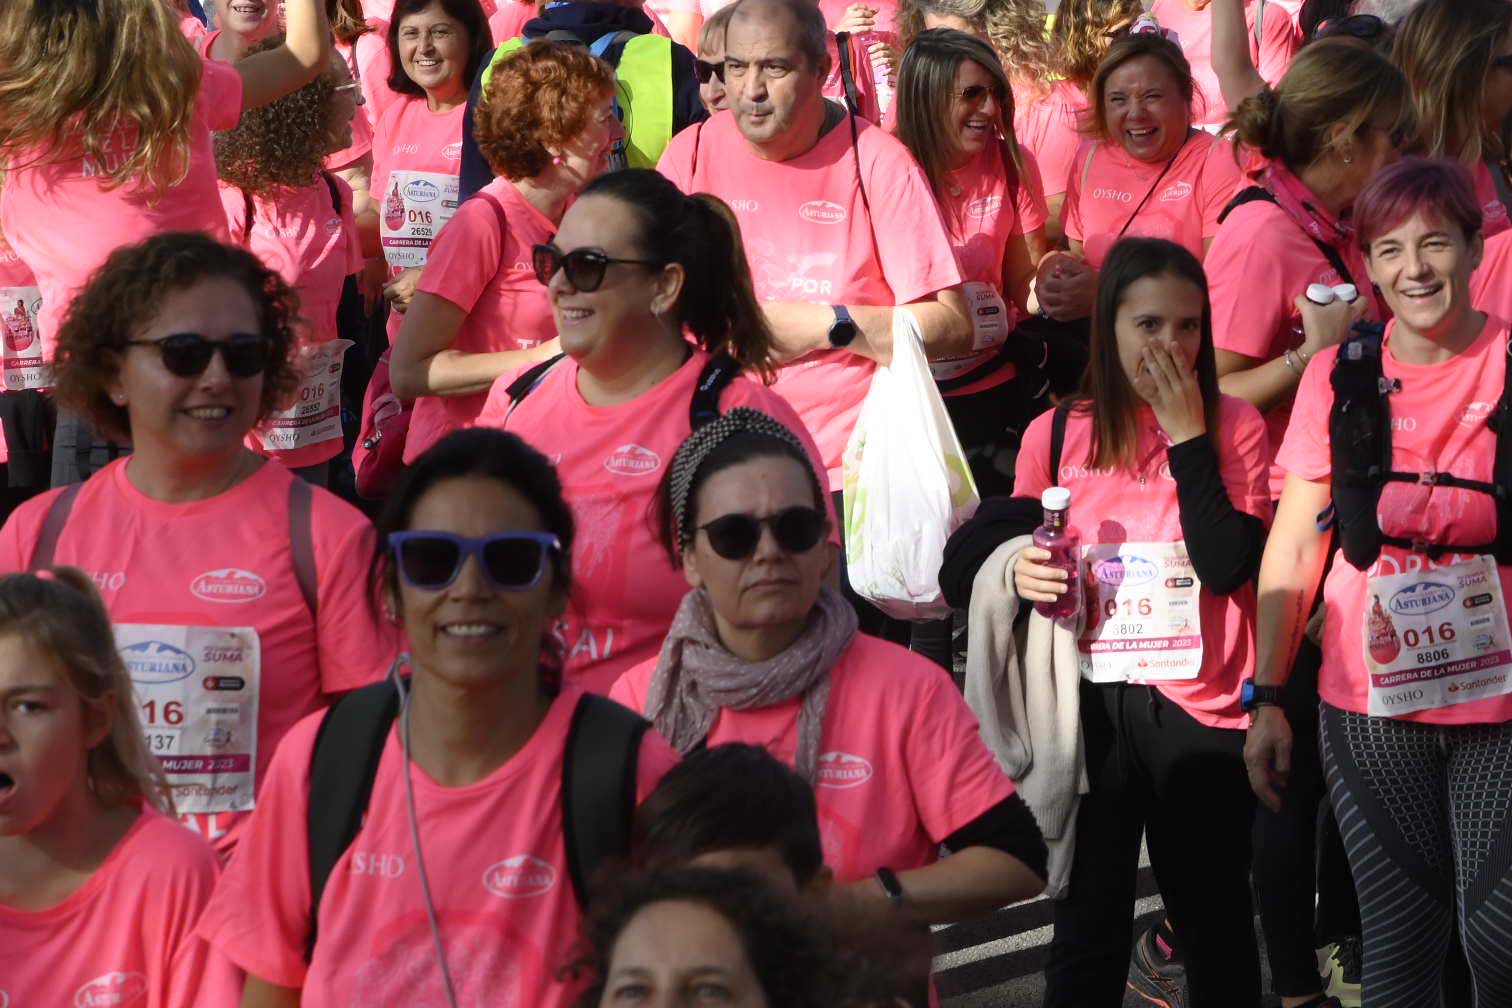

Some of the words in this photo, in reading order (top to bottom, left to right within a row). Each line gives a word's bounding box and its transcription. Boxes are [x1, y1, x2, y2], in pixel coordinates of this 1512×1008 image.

[1093, 187, 1132, 203] OYSHO
[408, 209, 432, 224] 016
[388, 252, 415, 261] OYSHO
[789, 278, 833, 294] POR
[301, 384, 325, 401] 016
[1101, 567, 1153, 579] ASTURIANA
[1104, 598, 1152, 617] 016
[1395, 594, 1450, 610] ASTURIANA
[1403, 622, 1456, 648] 016
[1112, 642, 1123, 650] DE
[1125, 642, 1138, 650] LA
[1138, 640, 1169, 649] MUJER
[203, 651, 243, 663] SUMA
[1417, 648, 1449, 664] 8806
[1380, 671, 1418, 685] CARRERA
[1420, 667, 1432, 677] DE
[1434, 666, 1446, 676] LA
[1447, 661, 1477, 673] MUJER
[1382, 689, 1424, 706] OYSHO
[1460, 675, 1507, 691] Santander
[143, 699, 184, 726] 16
[146, 735, 175, 751] 137
[163, 759, 204, 770] MUJER
